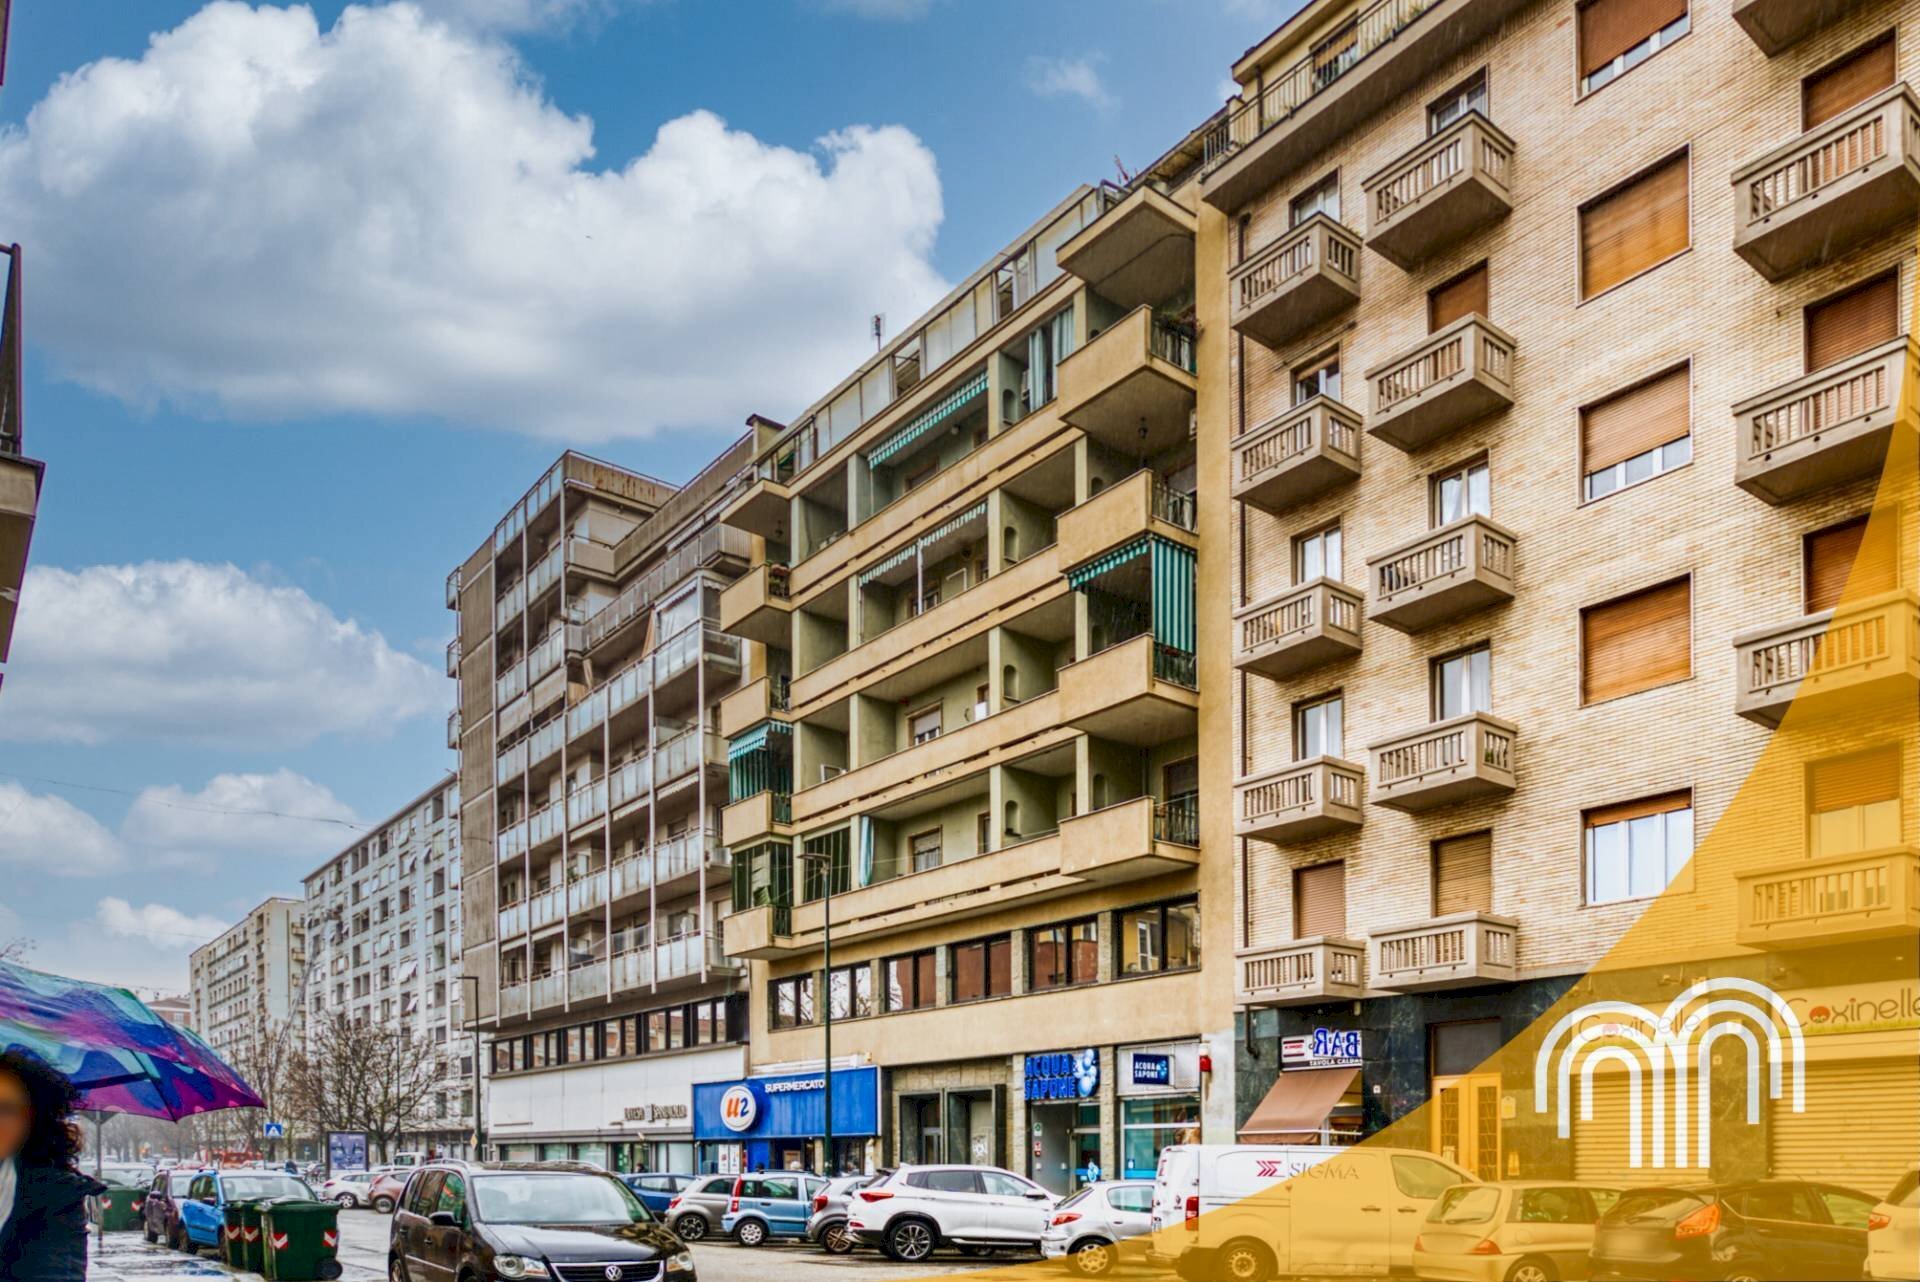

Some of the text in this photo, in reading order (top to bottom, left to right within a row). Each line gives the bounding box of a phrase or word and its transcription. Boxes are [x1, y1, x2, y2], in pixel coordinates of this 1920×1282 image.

[1025, 1054, 1070, 1077] ACQUA
[1134, 1061, 1156, 1070] ACQUA
[1134, 1070, 1158, 1079] SAPONE
[764, 1080, 826, 1093] SUPERMERCATO
[1025, 1076, 1076, 1100] SAPONE
[1289, 1162, 1360, 1180] SIGMA
